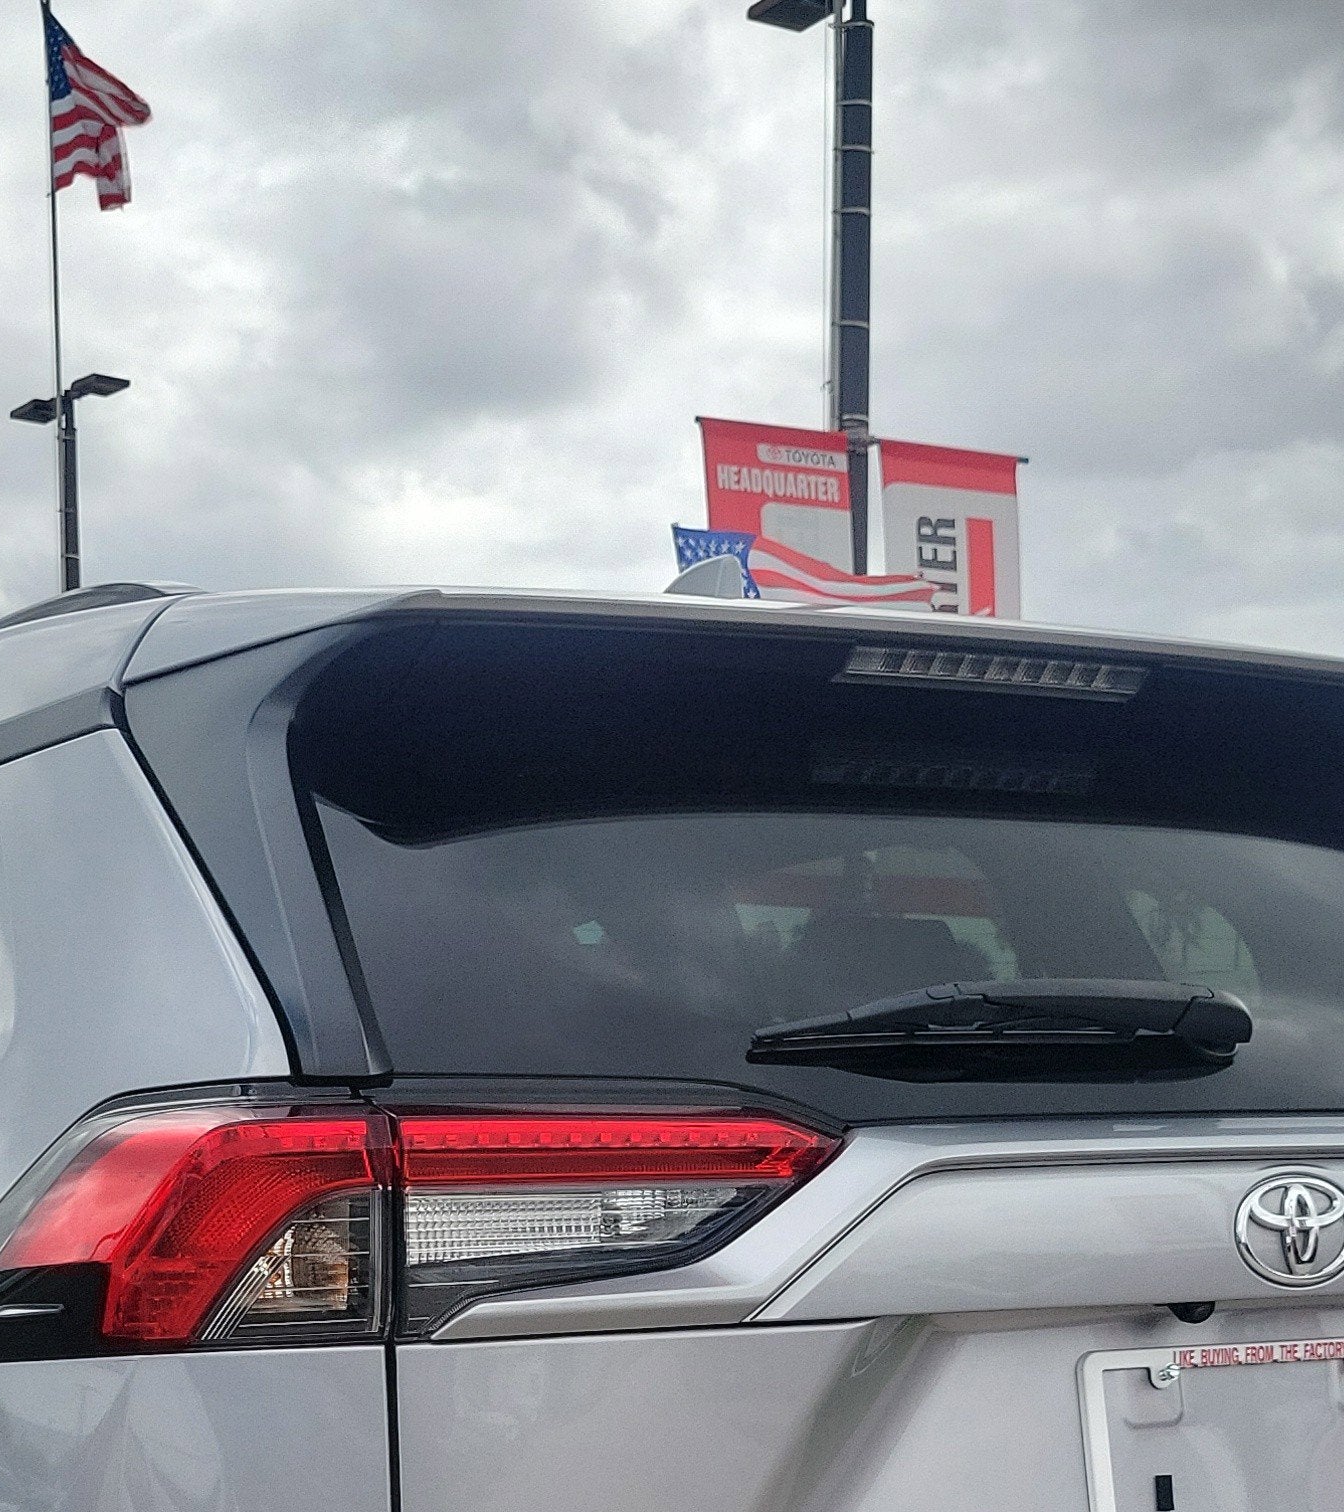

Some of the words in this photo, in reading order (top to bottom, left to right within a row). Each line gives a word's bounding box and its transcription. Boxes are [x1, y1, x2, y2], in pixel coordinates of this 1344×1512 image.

[785, 450, 836, 467] TOYOTA
[717, 465, 839, 502] HEADQUARTER
[1173, 1350, 1195, 1366] LIKE
[1201, 1347, 1239, 1365] BUYING
[1246, 1345, 1274, 1362] FROM
[1280, 1344, 1298, 1360] THE
